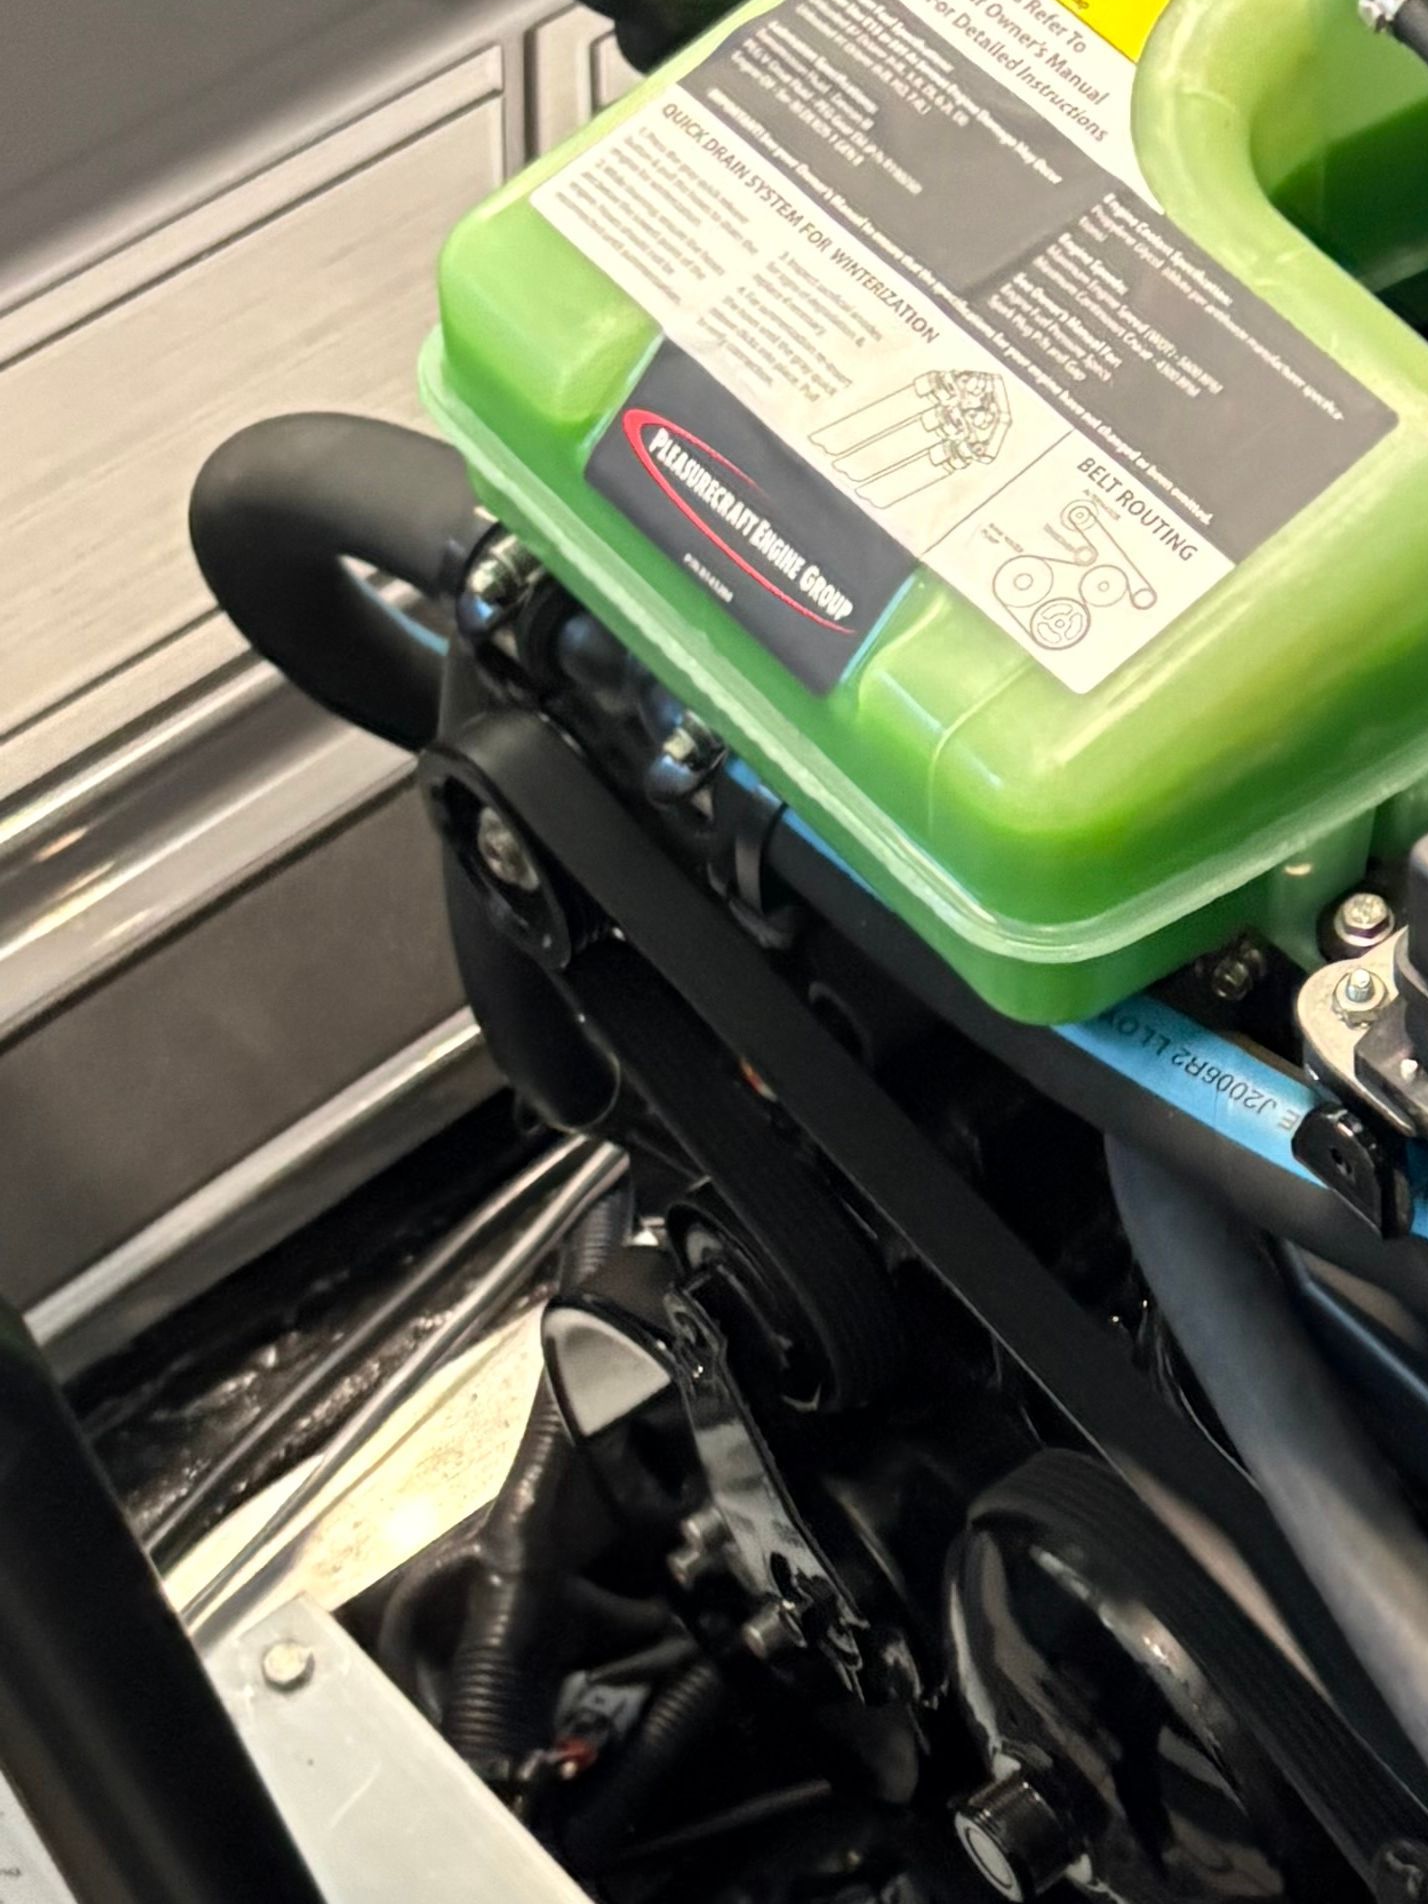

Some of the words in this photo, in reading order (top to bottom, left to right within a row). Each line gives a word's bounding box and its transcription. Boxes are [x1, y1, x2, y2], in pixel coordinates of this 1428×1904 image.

[950, 12, 1023, 72] Detailed
[1015, 64, 1112, 143] Instructions
[982, 1, 1052, 58] Owner's
[1044, 52, 1109, 106] Manual
[1063, 30, 1092, 54] To
[659, 101, 709, 144] QUICK
[700, 137, 751, 180] DRAIN
[743, 174, 806, 228] SYSTEM
[797, 221, 834, 252] FOR
[828, 246, 942, 344] WINTERIZATION
[1076, 455, 1123, 496] BELT
[1114, 488, 1199, 561] ROUTING
[744, 520, 812, 581] ENGINE
[792, 564, 859, 623] GROUP
[1104, 1012, 1172, 1058] LLOY
[1172, 1045, 1277, 1118] J2006R2
